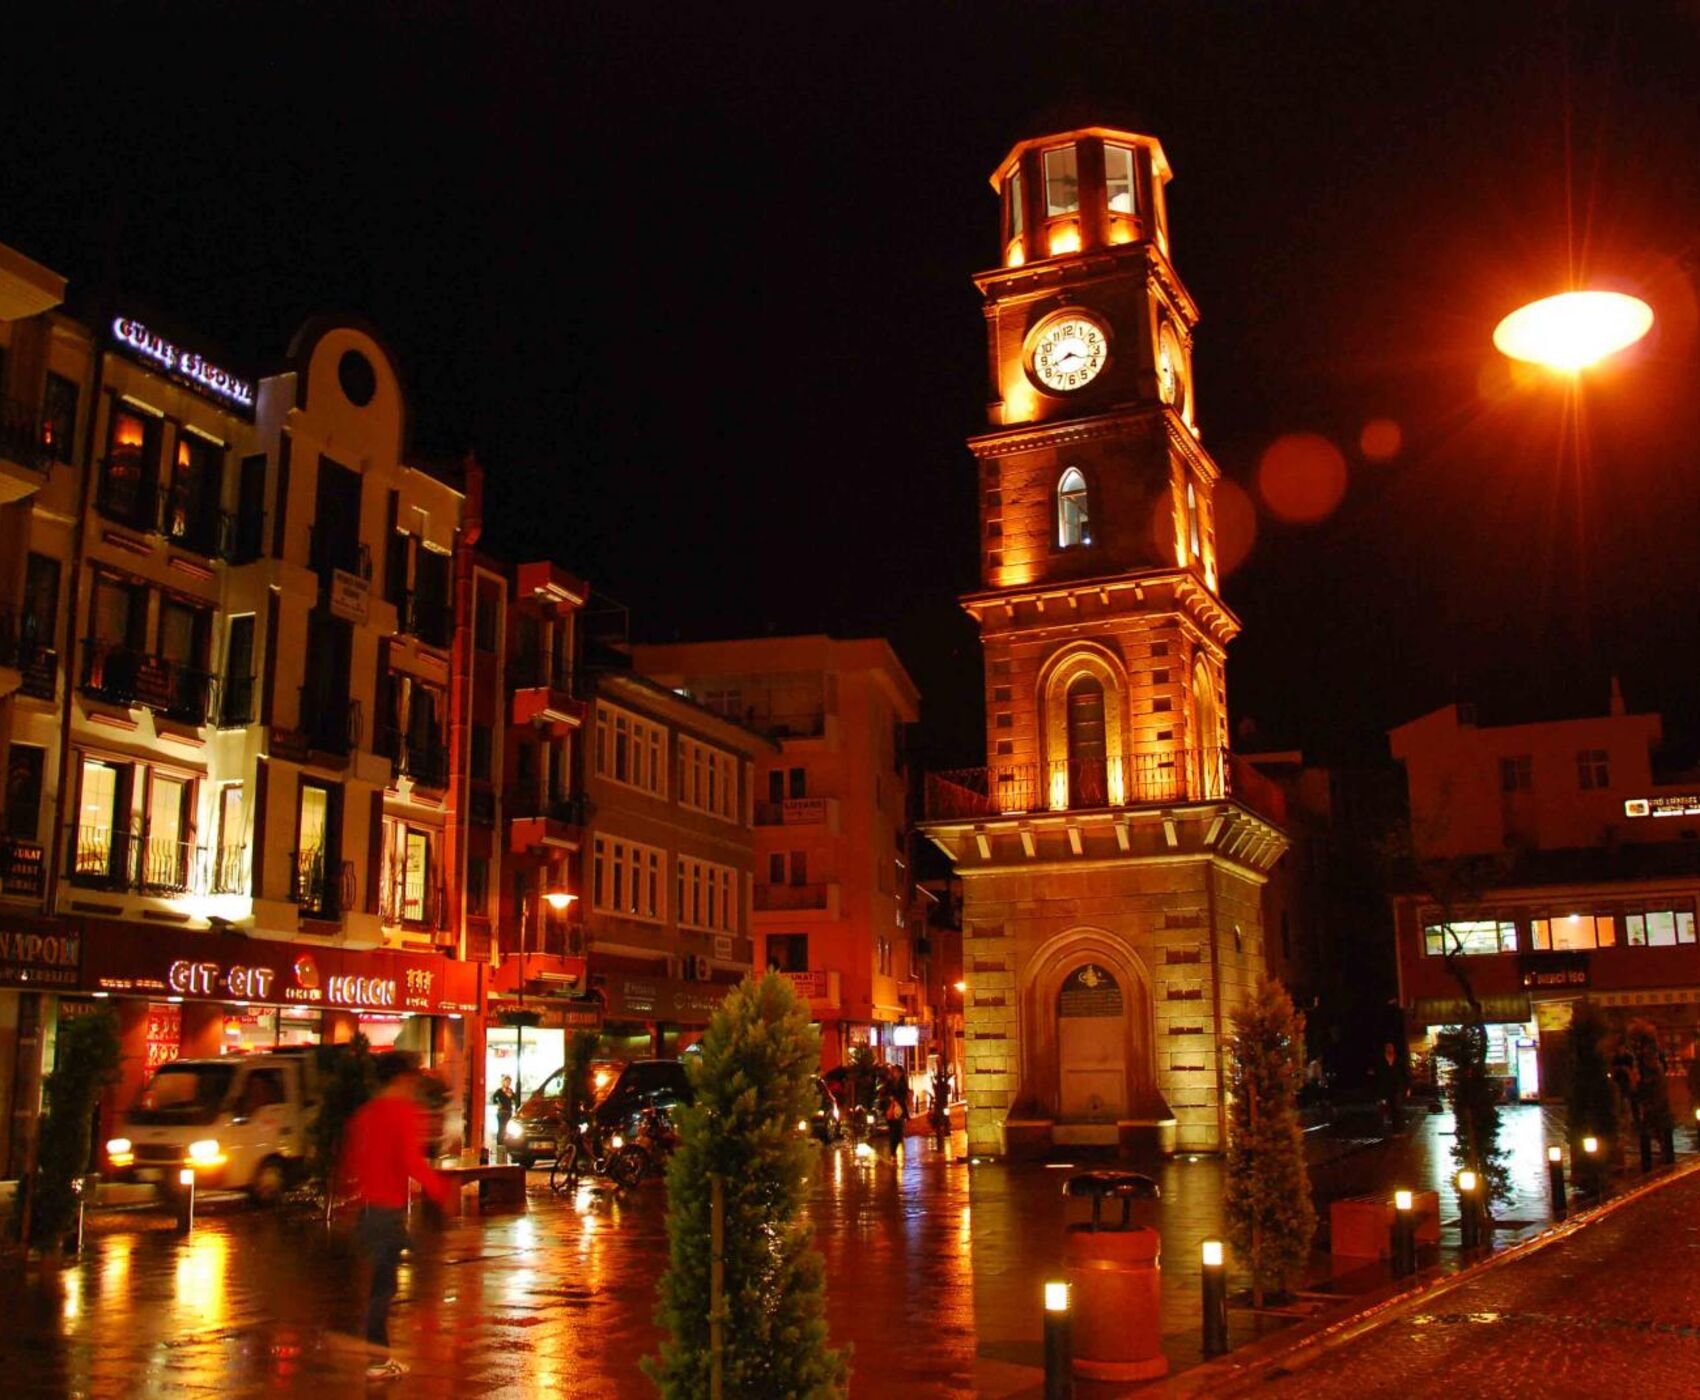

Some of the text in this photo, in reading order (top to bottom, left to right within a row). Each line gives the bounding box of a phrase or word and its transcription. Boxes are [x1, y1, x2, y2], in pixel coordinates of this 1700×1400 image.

[1063, 325, 1073, 336] 12
[1053, 332, 1060, 341] 11
[1088, 333, 1096, 343] 2
[1042, 342, 1052, 353] 10
[1094, 345, 1101, 355] 3
[1040, 356, 1048, 366] 9
[1090, 359, 1097, 368] 4
[1045, 368, 1052, 378] 8
[1080, 369, 1088, 380] 5
[1056, 374, 1063, 385] 7
[1069, 374, 1076, 385] 6
[328, 975, 396, 1006] HORON
